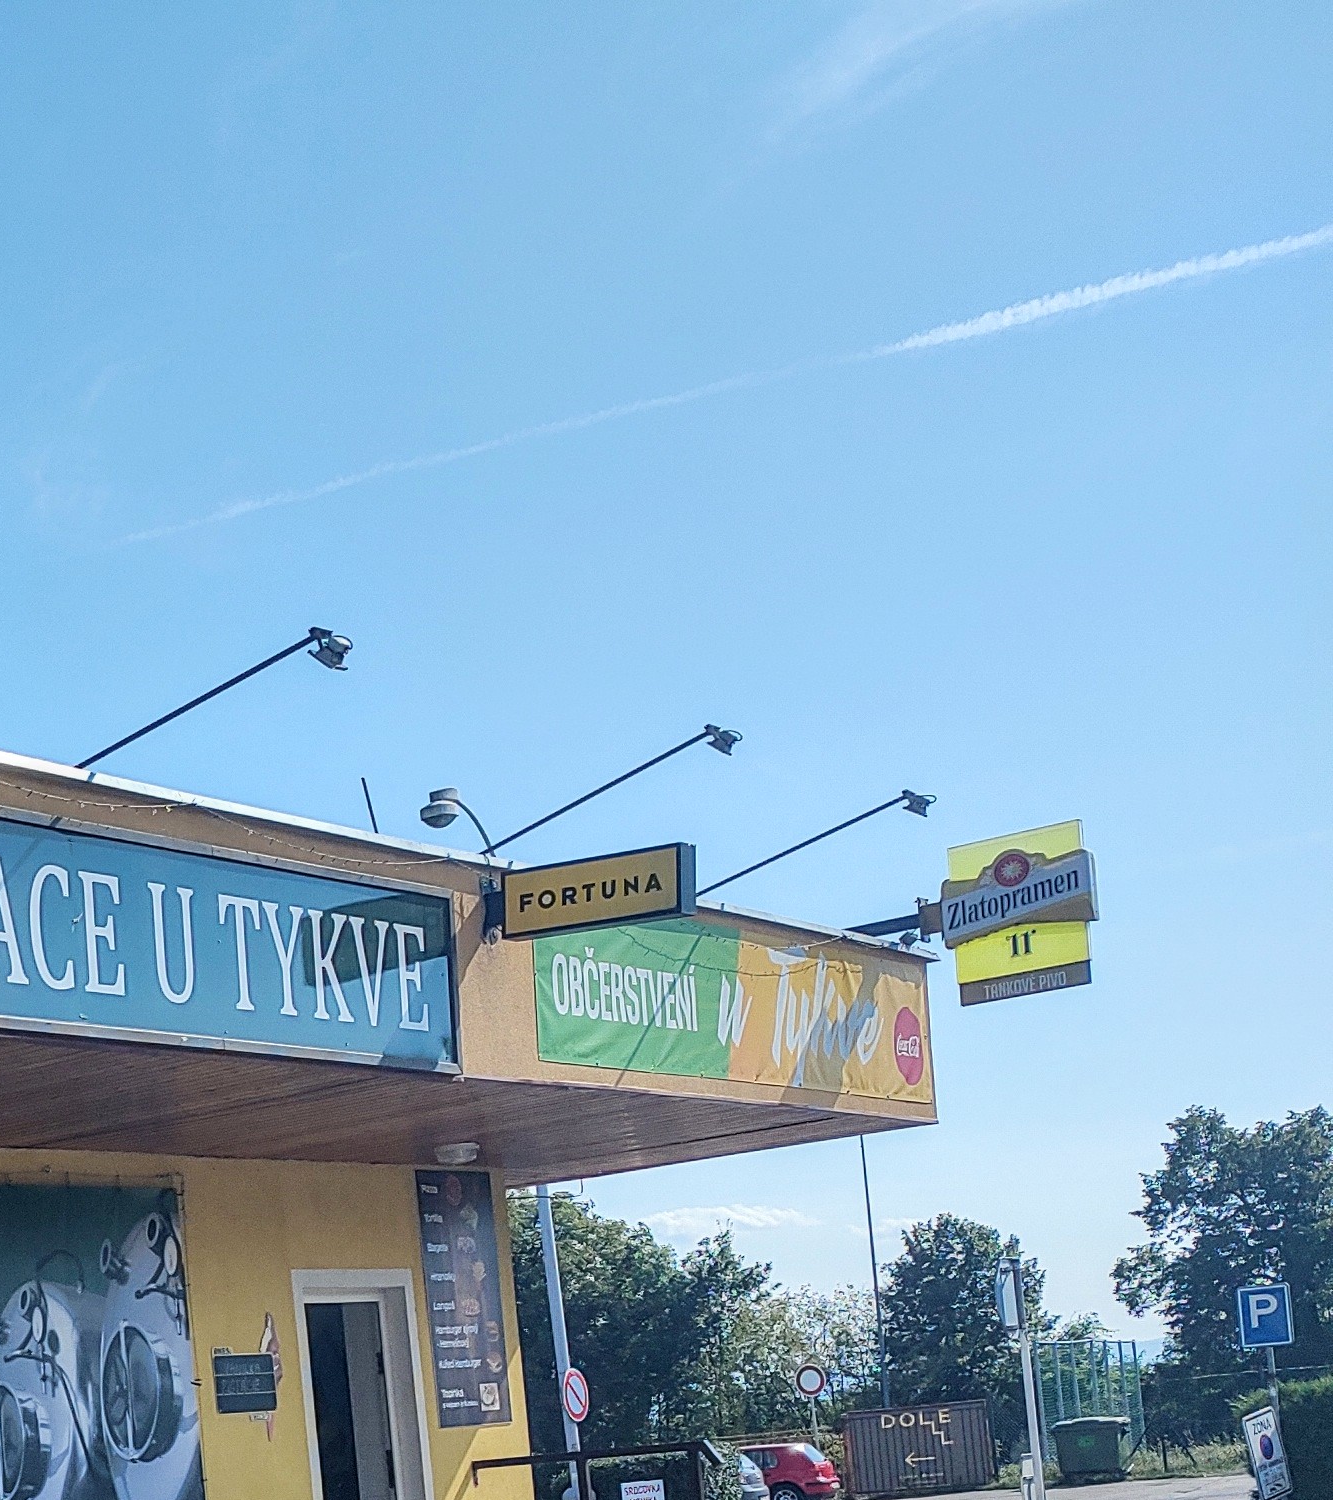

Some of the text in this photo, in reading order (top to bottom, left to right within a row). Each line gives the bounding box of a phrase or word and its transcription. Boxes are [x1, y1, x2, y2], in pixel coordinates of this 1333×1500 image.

[519, 873, 662, 912] FORTUNA
[948, 870, 1079, 930] Zlatopramen
[147, 882, 193, 1004] U
[218, 894, 429, 1031] TYKVE
[552, 946, 698, 1032] OBČERSTVENÍ
[984, 971, 1067, 1000] TANKOVÉ PIVO
[1248, 1294, 1278, 1328] P
[881, 1408, 951, 1429] DOLE
